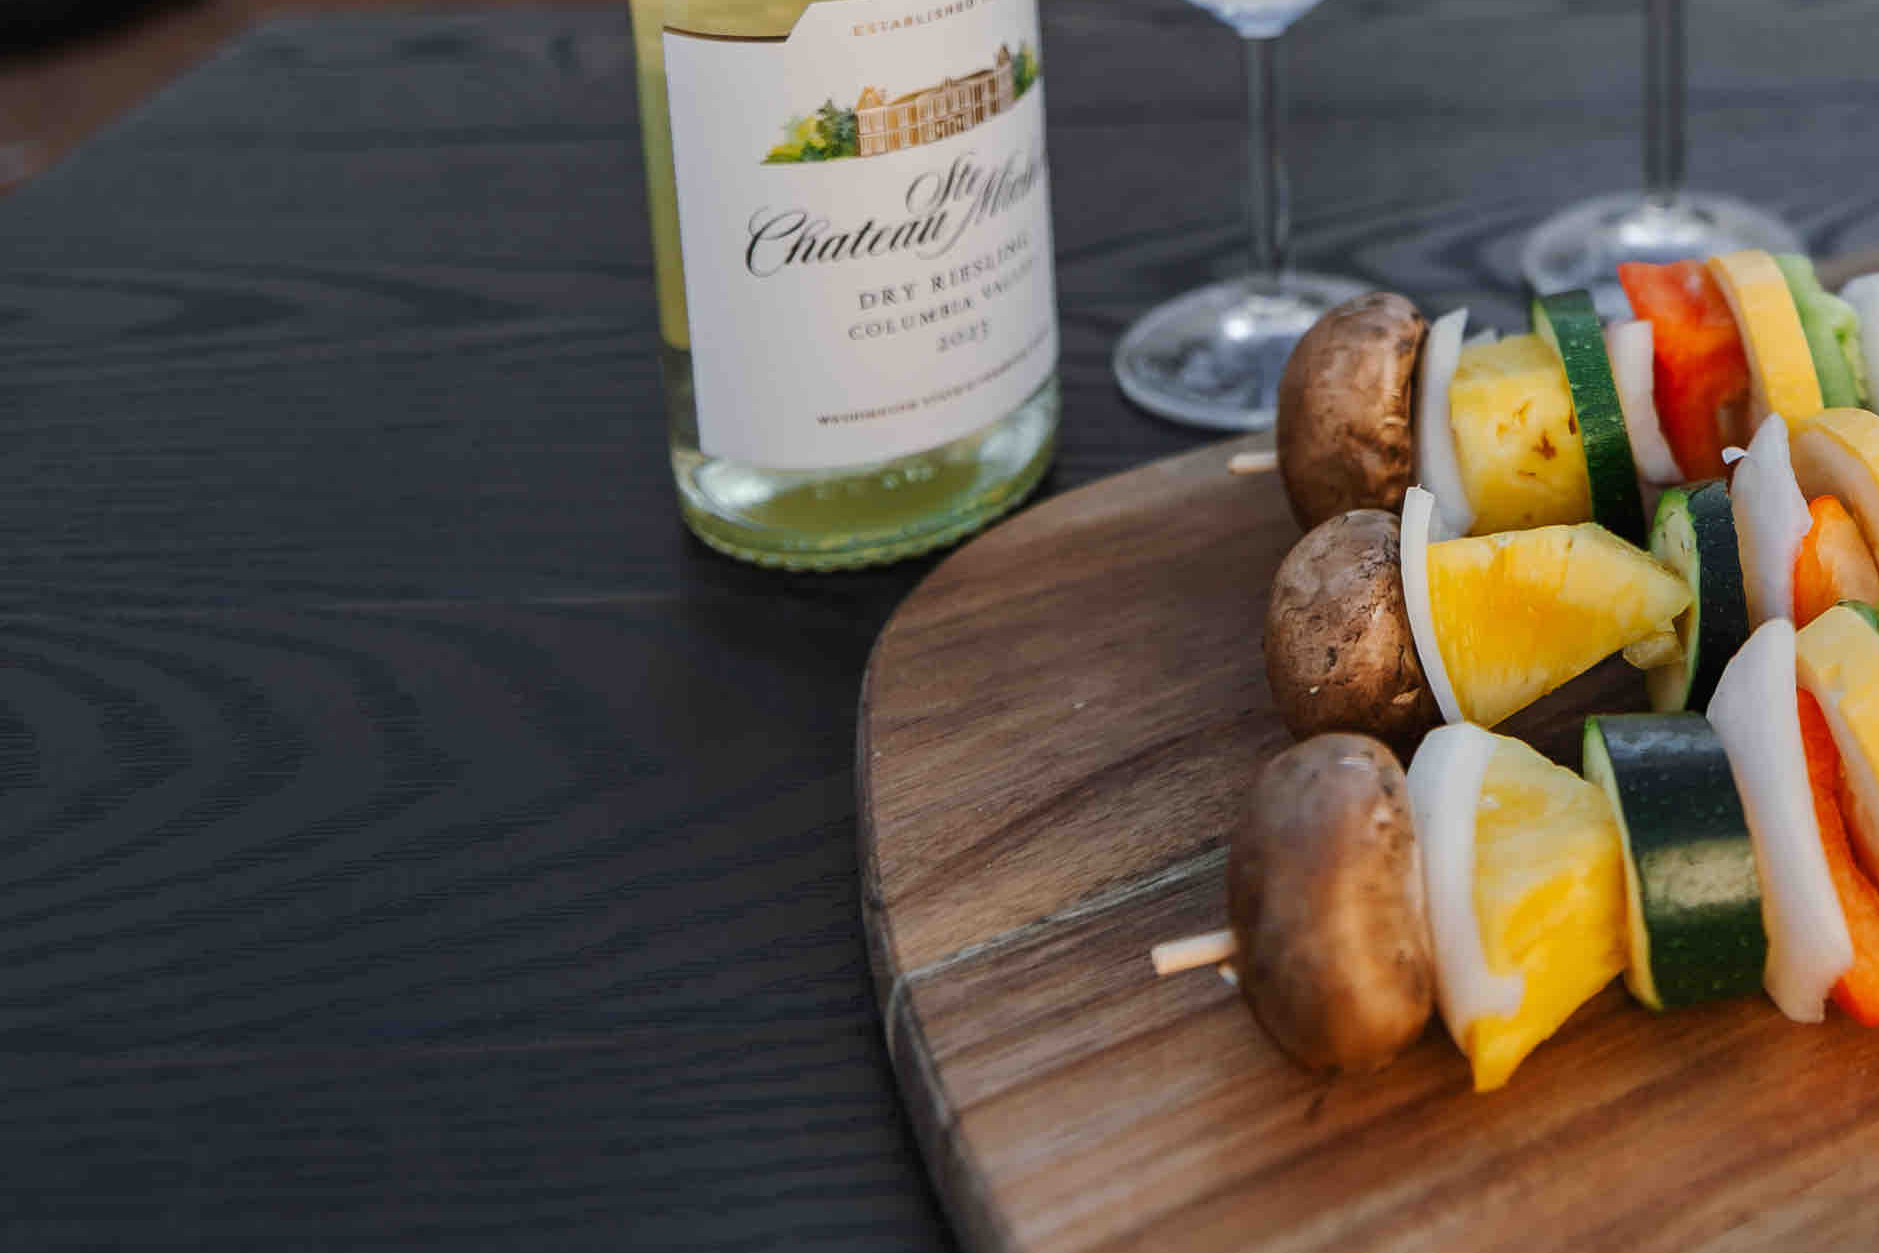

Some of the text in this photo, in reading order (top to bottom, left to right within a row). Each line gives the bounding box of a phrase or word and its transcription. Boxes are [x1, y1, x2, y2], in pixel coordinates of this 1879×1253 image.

[745, 205, 948, 279] Chateau
[859, 231, 1030, 311] DRY RIESLING
[848, 296, 976, 341] COLUMBIA
